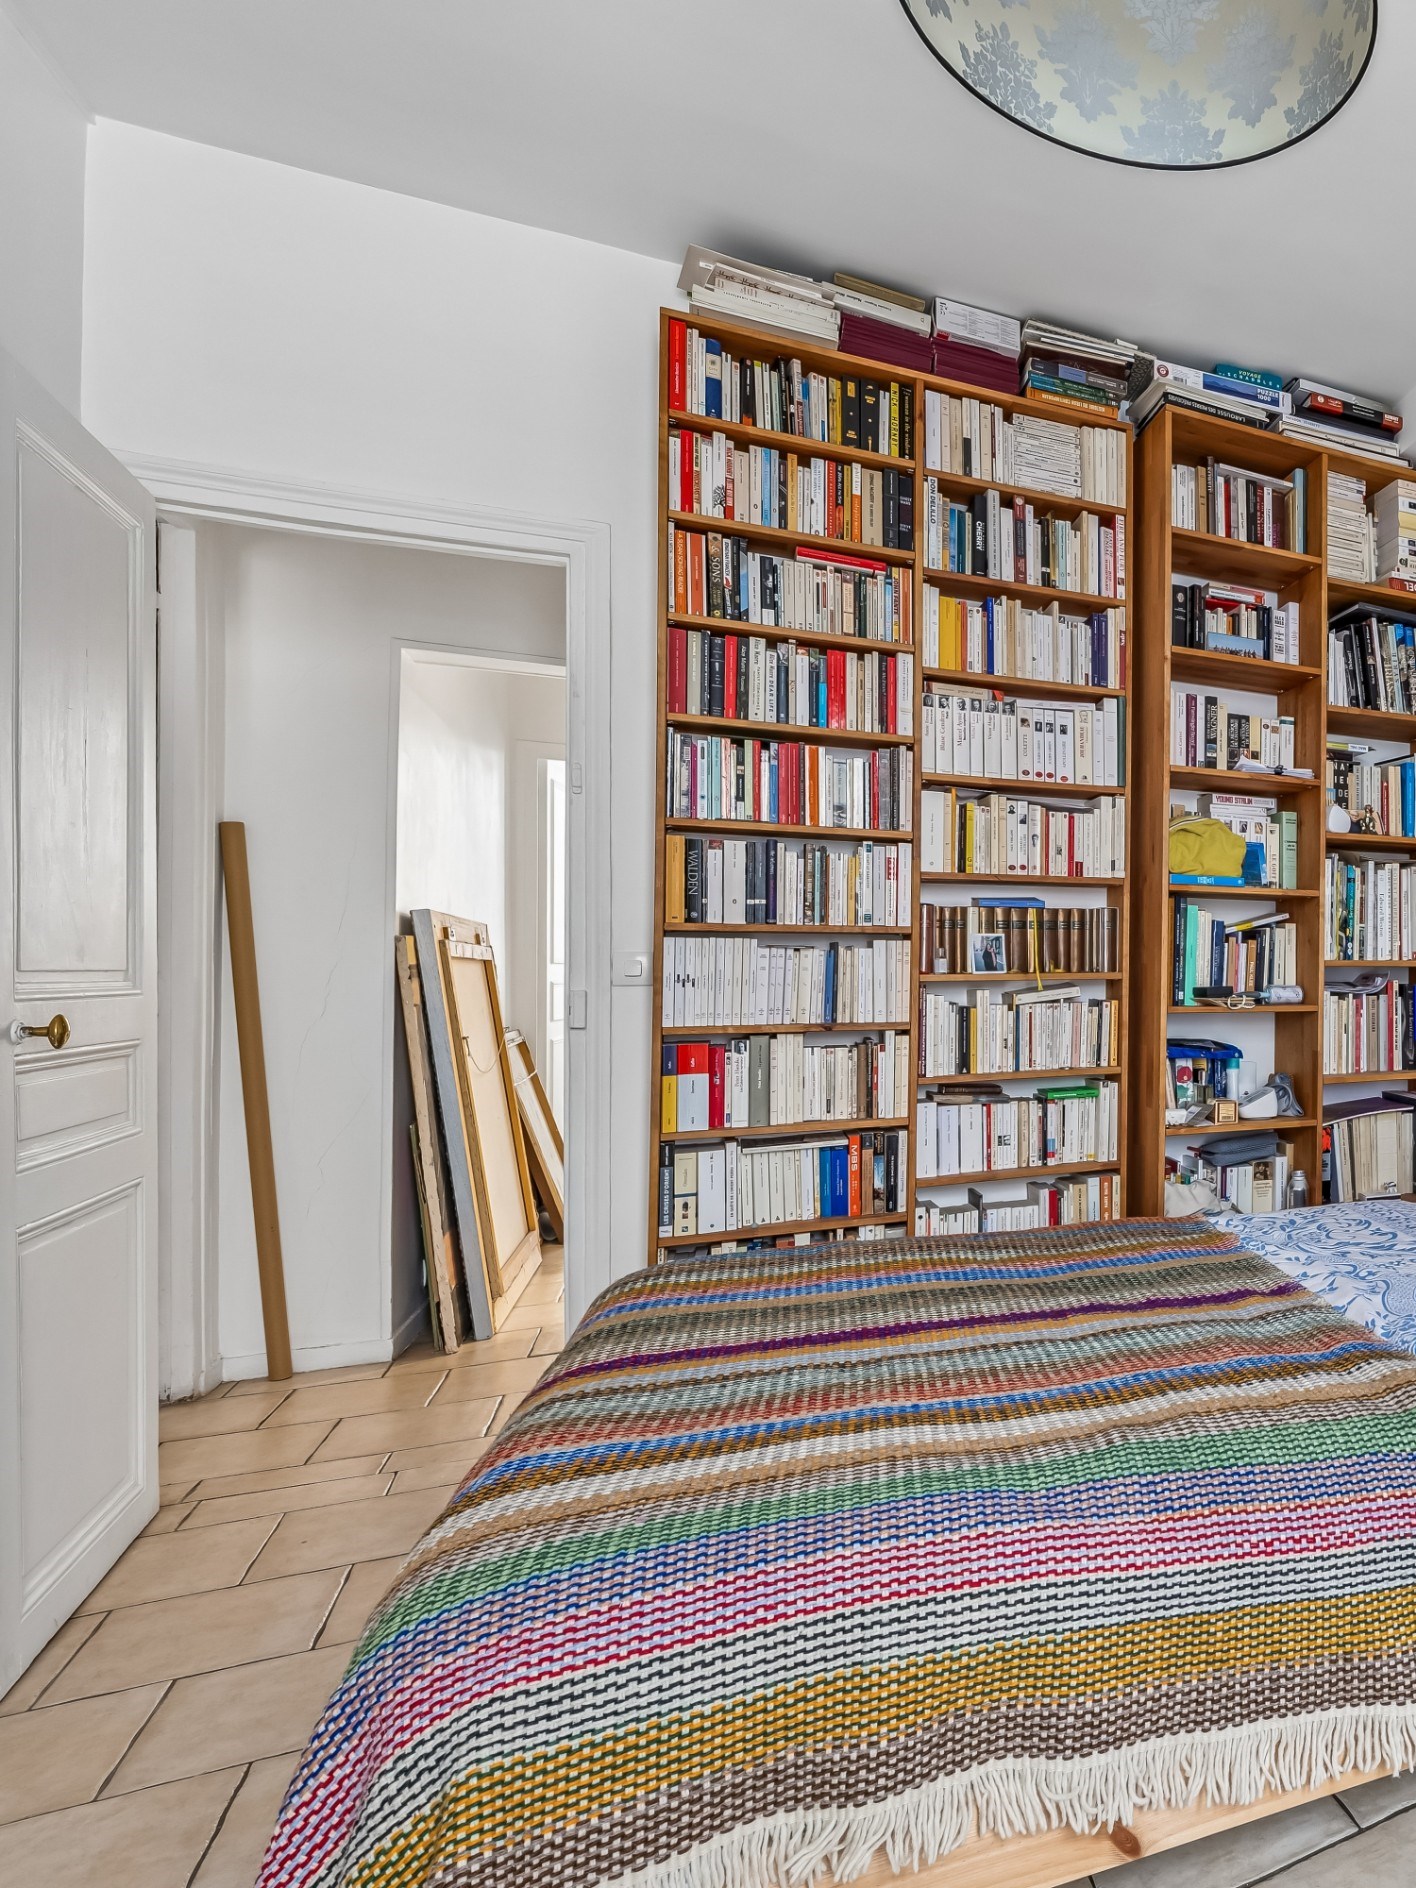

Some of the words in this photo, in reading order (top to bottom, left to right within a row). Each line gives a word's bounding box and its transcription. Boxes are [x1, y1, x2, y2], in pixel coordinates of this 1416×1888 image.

[1237, 370, 1261, 379] VOYAGE
[1256, 388, 1278, 397] PUZZLE
[1257, 394, 1271, 402] 1000
[1217, 409, 1245, 422] LAROUSSE
[711, 556, 721, 584] SONS
[1383, 662, 1393, 692] SYRIE
[1215, 795, 1233, 804] YOUNG
[688, 850, 698, 895] WALDEN
